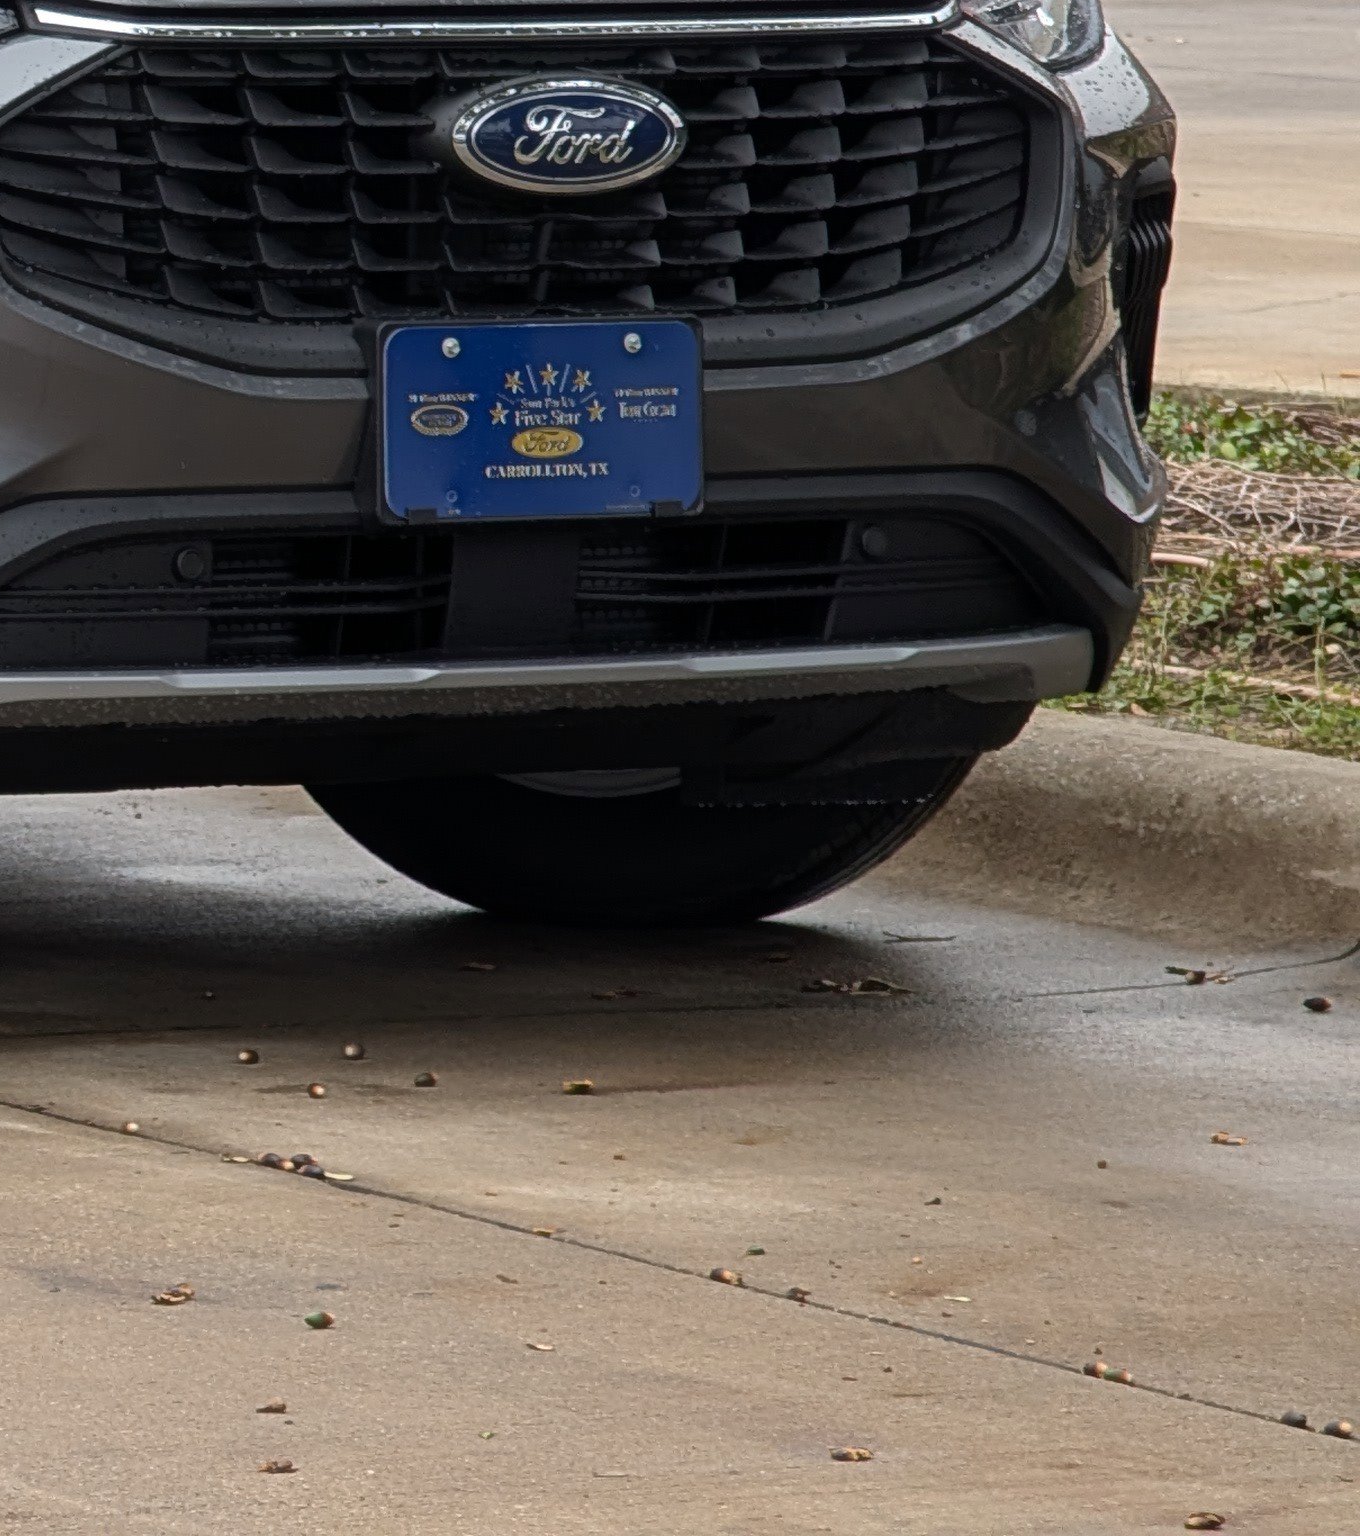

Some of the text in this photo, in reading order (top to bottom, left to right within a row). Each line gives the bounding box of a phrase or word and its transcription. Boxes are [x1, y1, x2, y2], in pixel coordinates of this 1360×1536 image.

[514, 104, 635, 165] Ford
[514, 410, 582, 426] Five Star
[523, 432, 570, 452] Ford
[589, 462, 609, 476] TX
